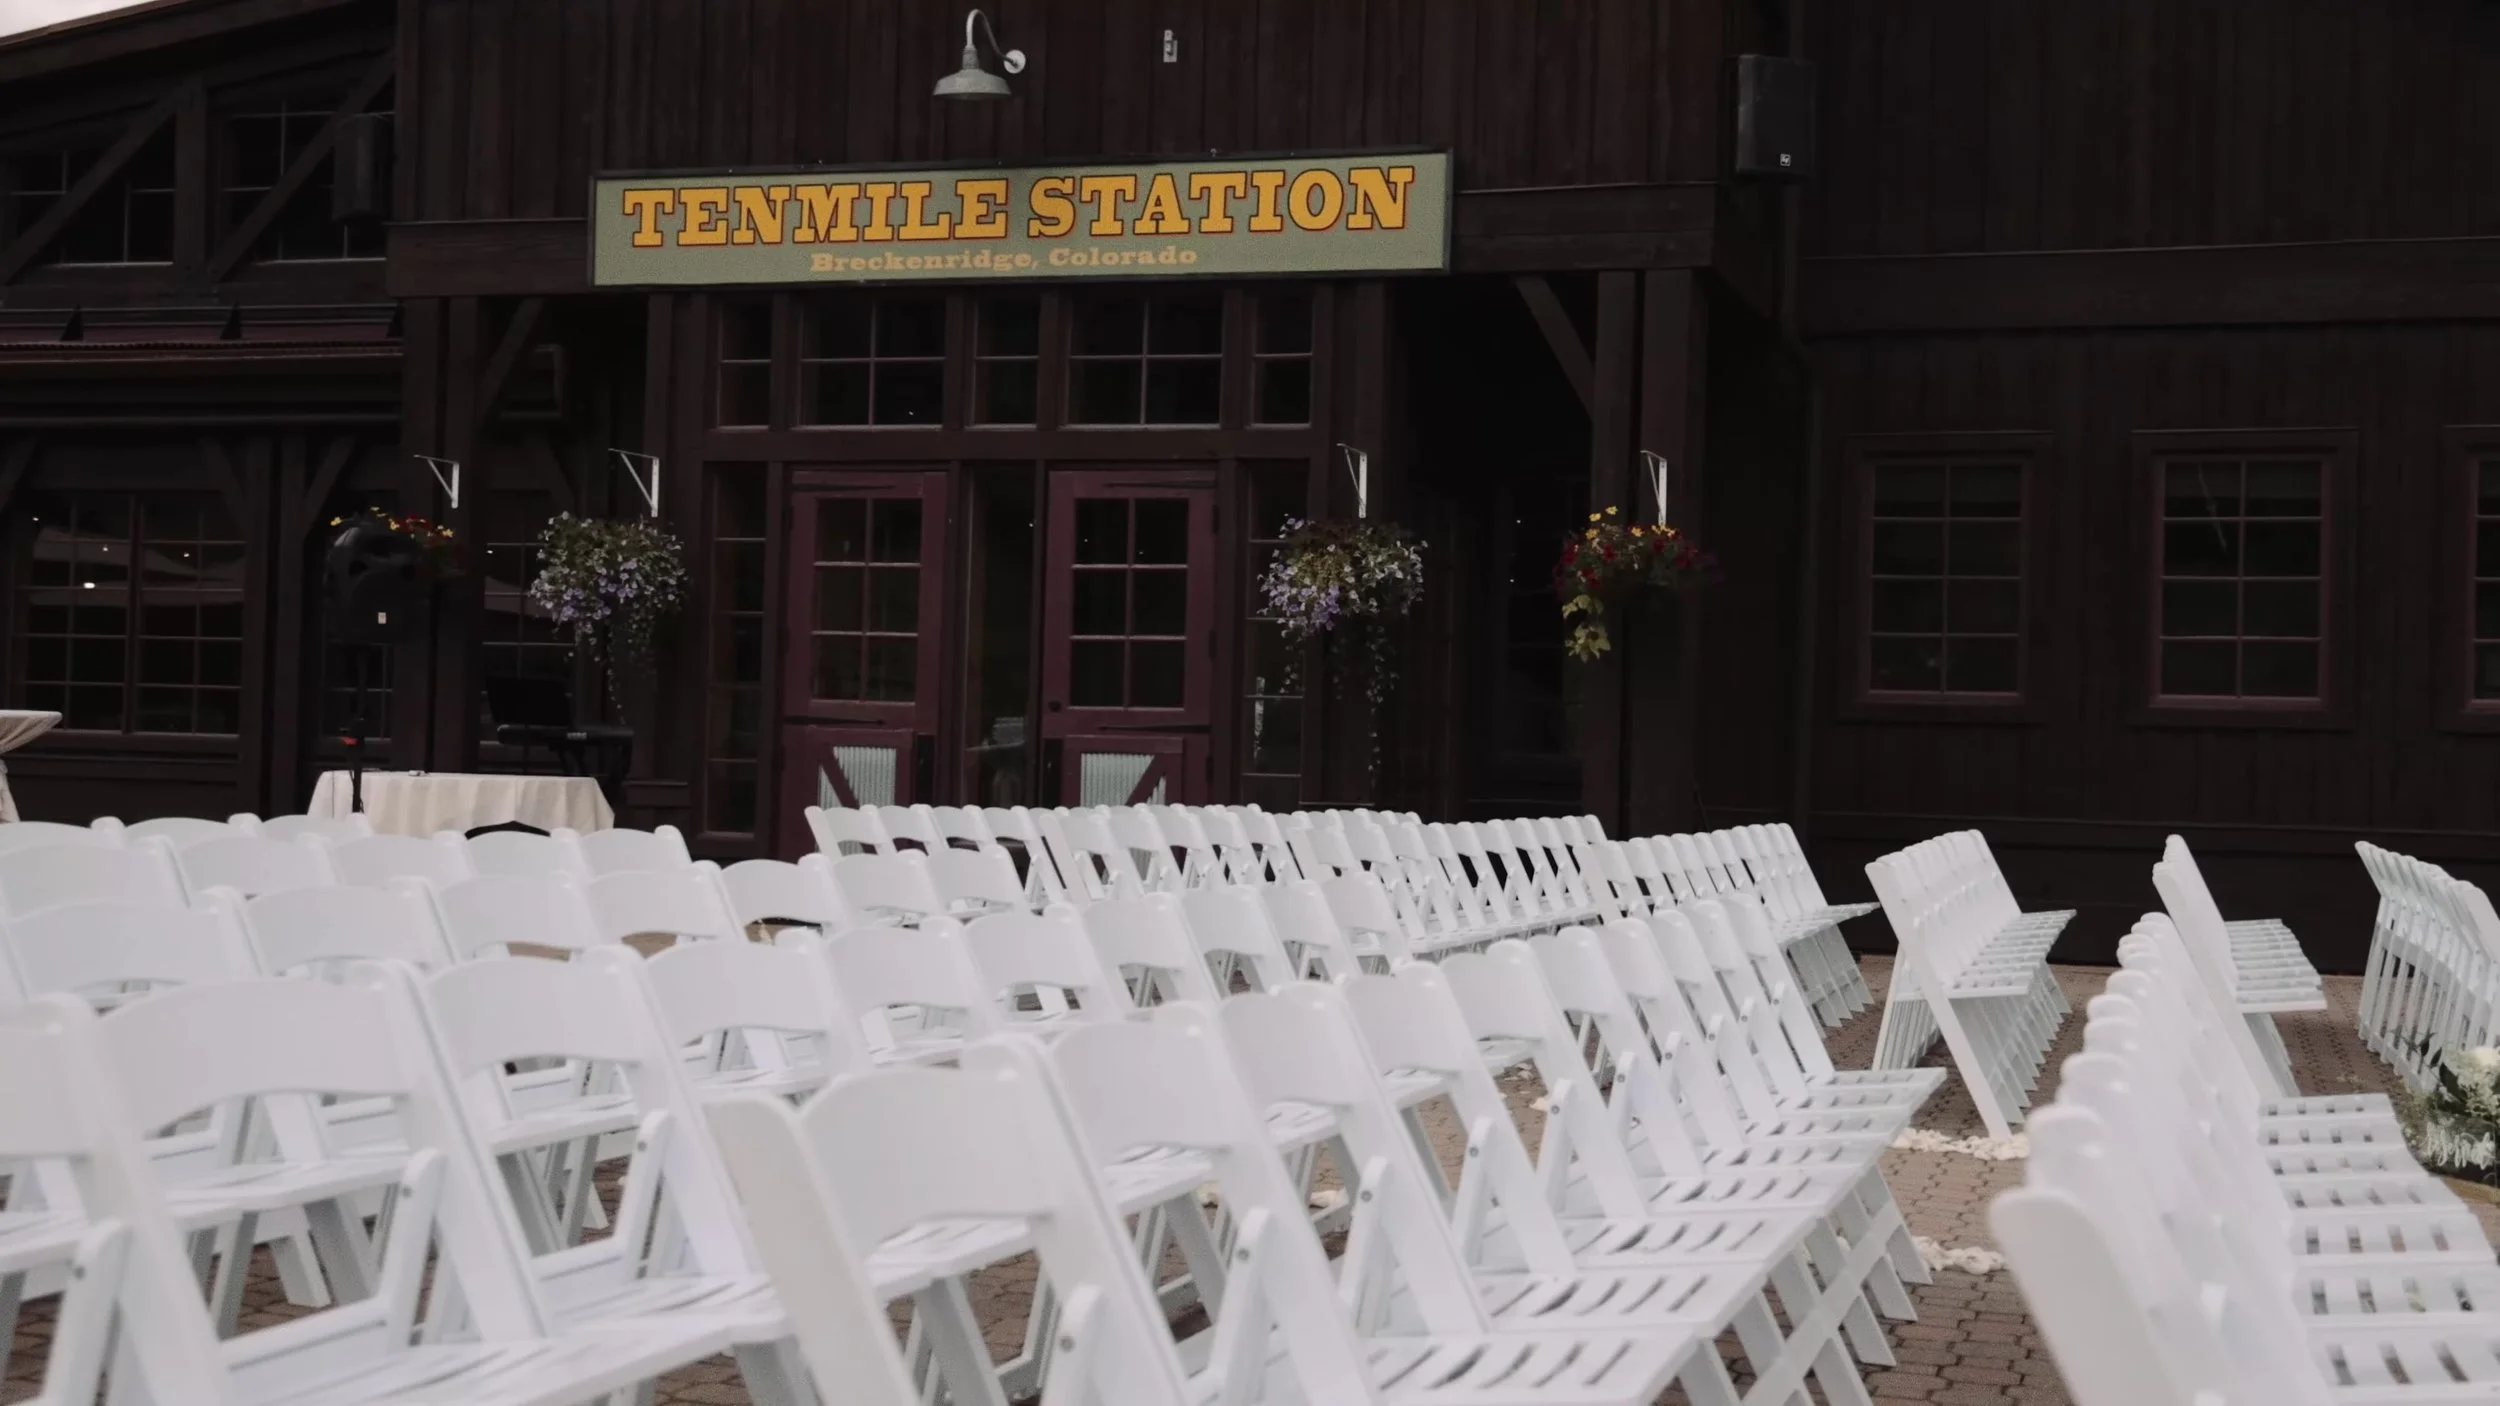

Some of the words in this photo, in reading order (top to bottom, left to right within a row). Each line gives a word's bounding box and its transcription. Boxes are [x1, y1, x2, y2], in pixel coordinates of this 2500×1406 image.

[623, 178, 1008, 247] TENMILE
[1027, 166, 1415, 238] STATION
[809, 250, 1039, 274] Breckenridge,
[1048, 246, 1198, 267] Colorado
